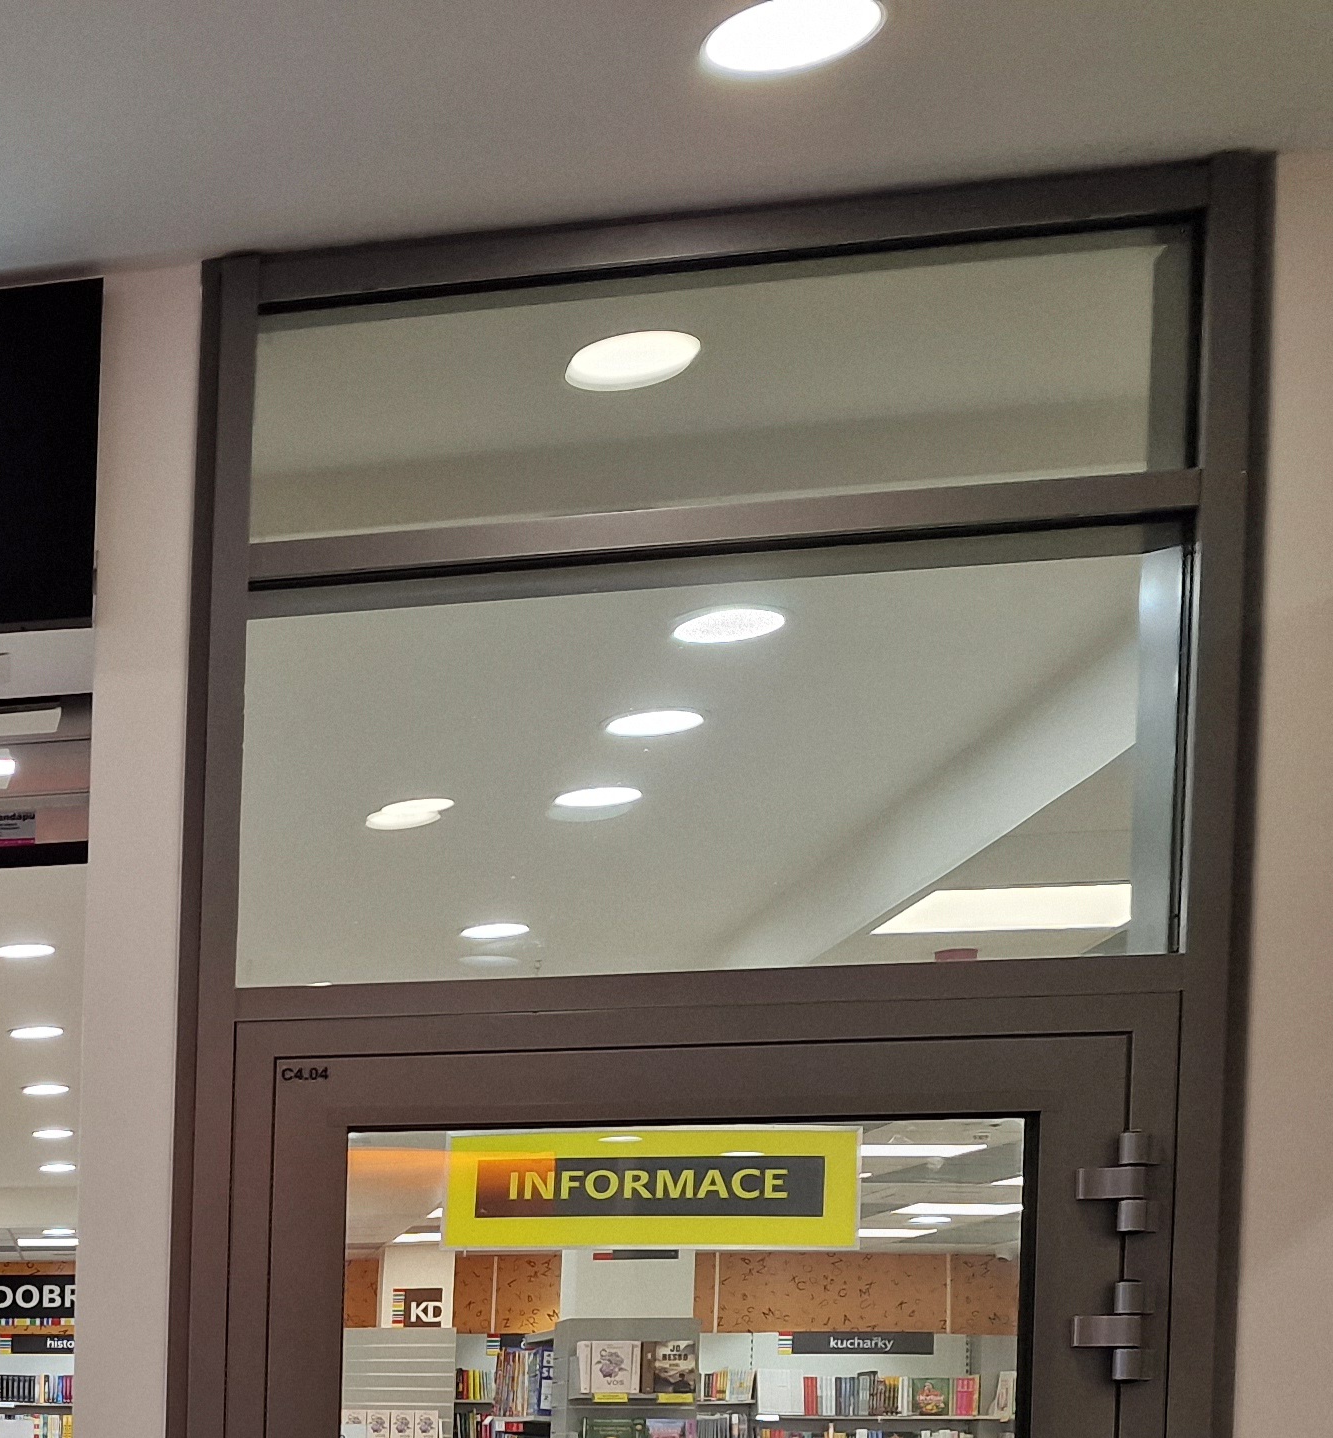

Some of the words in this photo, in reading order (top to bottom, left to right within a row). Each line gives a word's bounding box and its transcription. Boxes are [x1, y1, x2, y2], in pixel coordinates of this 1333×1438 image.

[281, 1067, 329, 1082] C4.04
[508, 1168, 789, 1201] INFORMACE
[410, 1300, 443, 1323] KD
[829, 1336, 894, 1352] kuchařky
